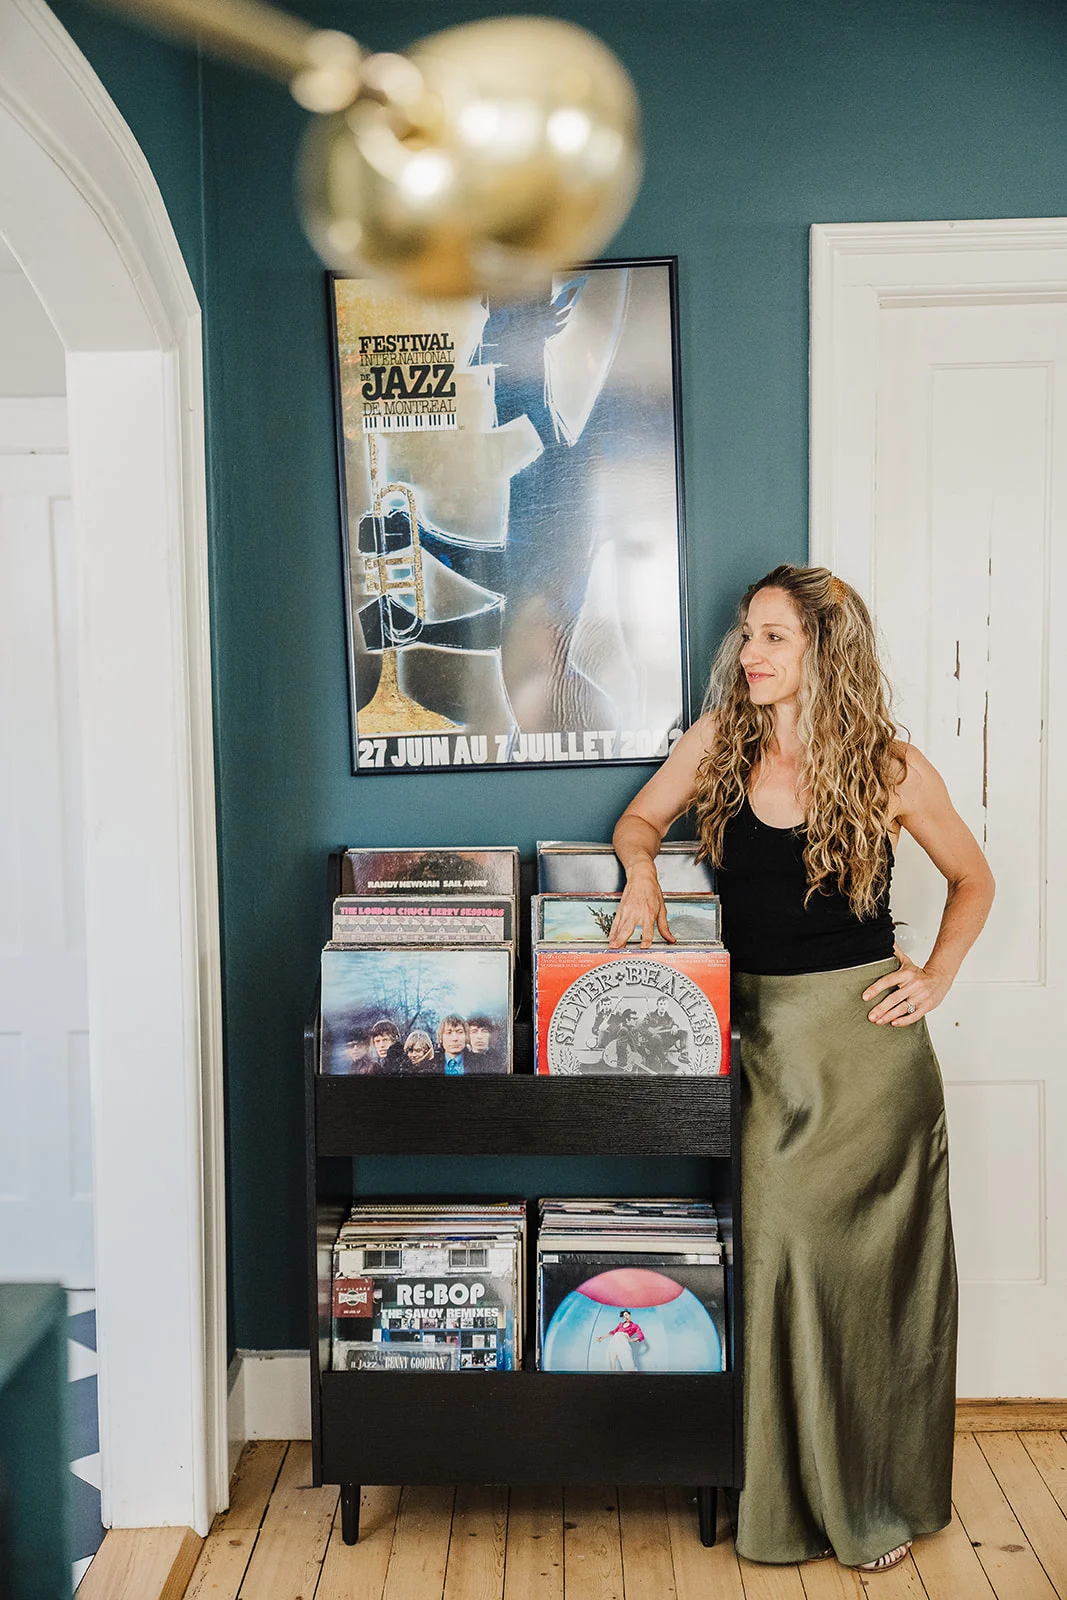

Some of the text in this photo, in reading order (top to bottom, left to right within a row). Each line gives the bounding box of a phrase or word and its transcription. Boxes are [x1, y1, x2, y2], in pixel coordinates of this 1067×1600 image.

[359, 333, 455, 353] FESTIVAL
[360, 351, 455, 366] INTERNATIONAL
[362, 364, 456, 400] JAZZ
[363, 399, 457, 416] DE MONTREAL
[358, 739, 387, 767] 27
[391, 737, 450, 767] JUIN
[453, 735, 488, 765] AU
[495, 735, 509, 763] 7
[513, 730, 617, 762] JUILLET
[400, 880, 440, 888] NEWMAN
[443, 880, 462, 888] SAIL
[463, 879, 488, 888] AWAY
[340, 907, 504, 917] THE LONDON CHUCK BERRY SESSIONS
[555, 966, 714, 1046] SILVER BEATLES
[380, 1308, 500, 1319] THE SAVOY REMIXES
